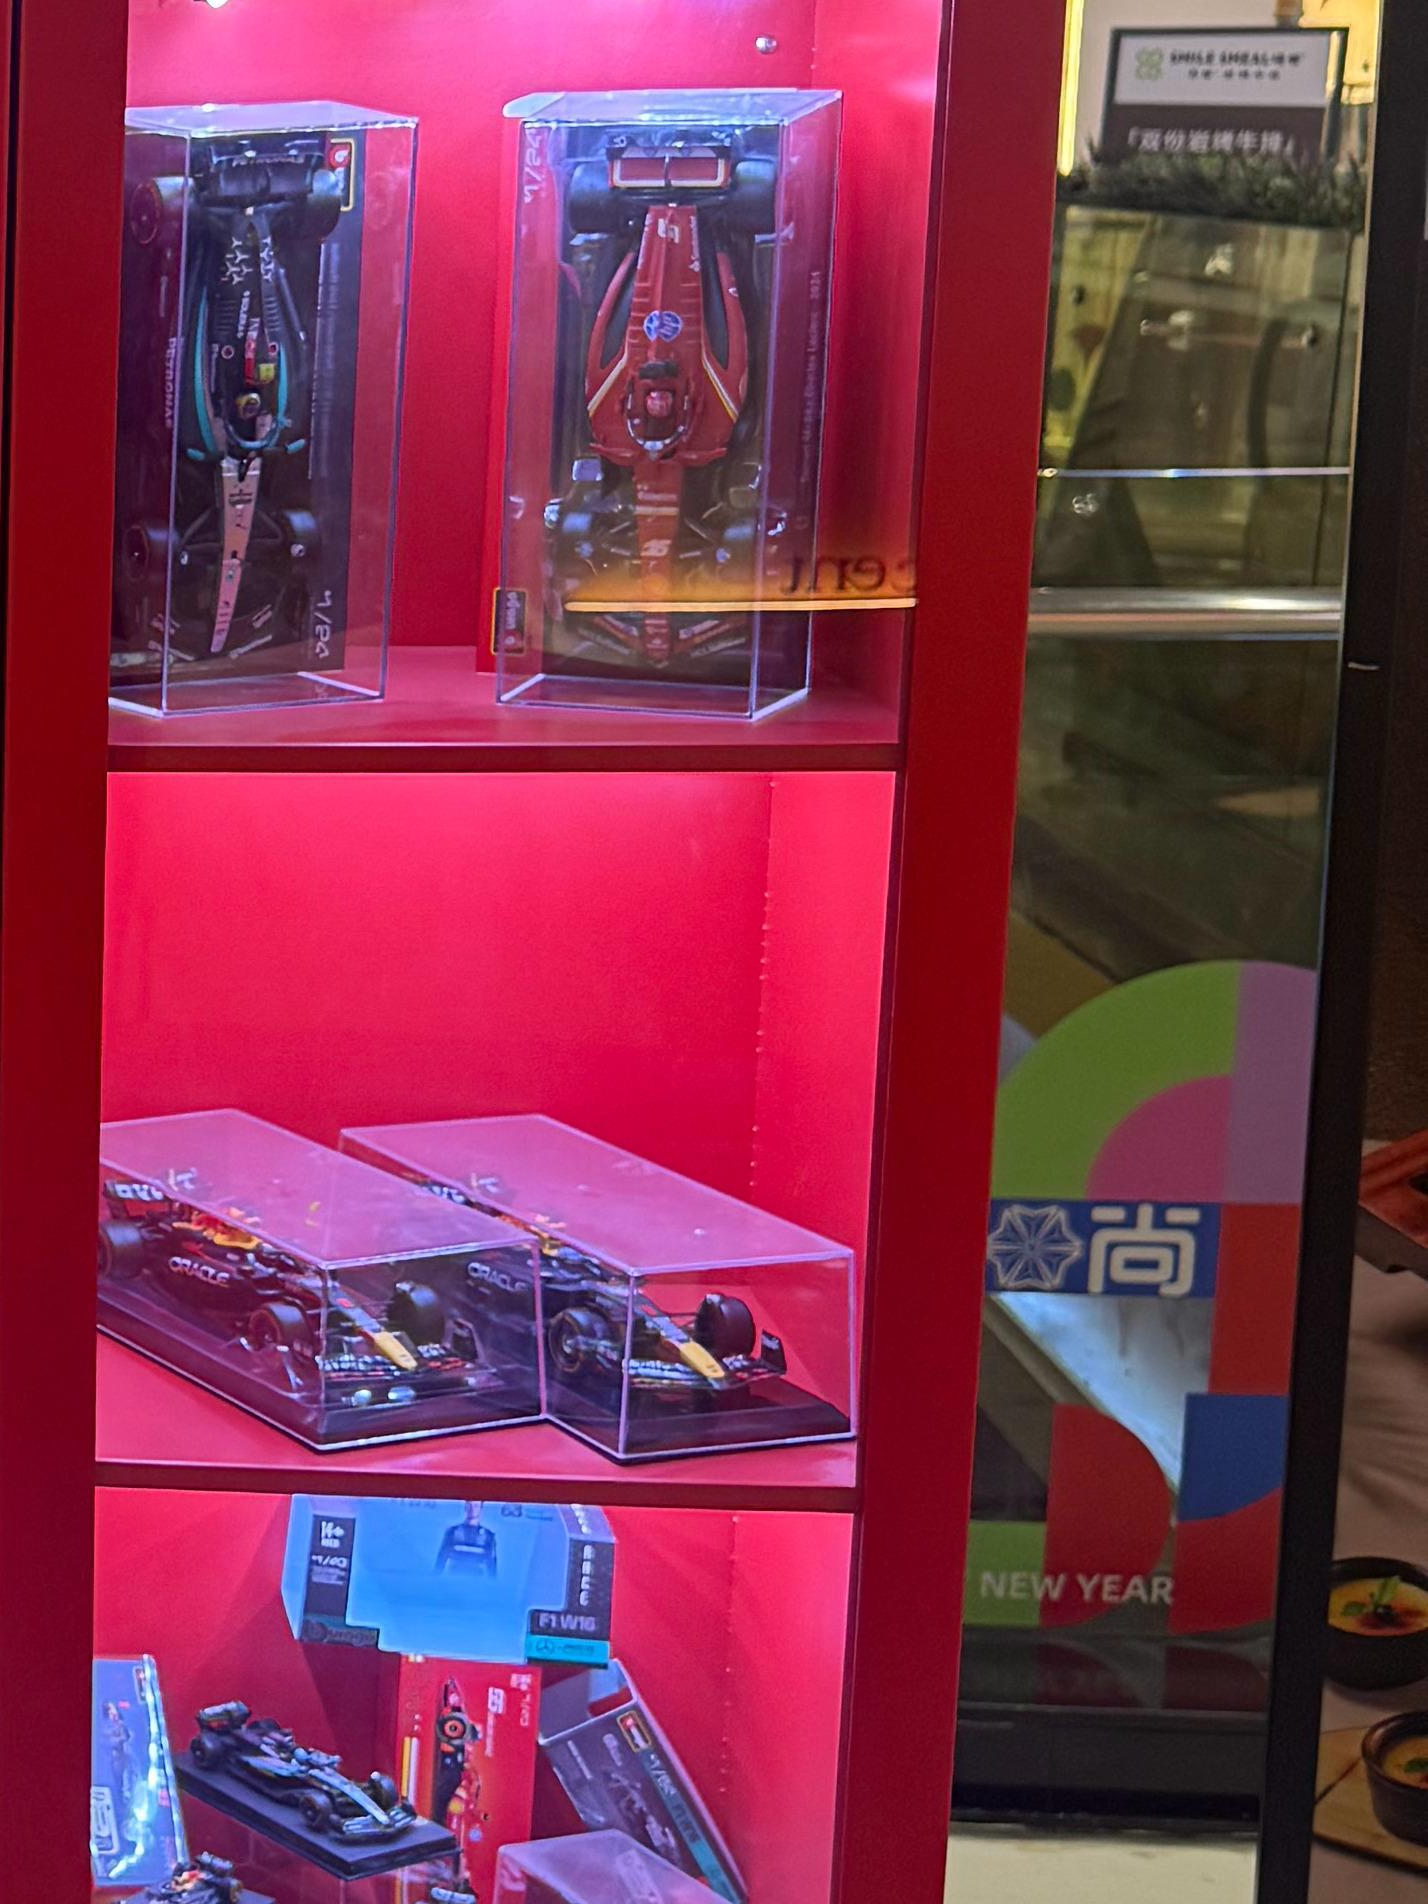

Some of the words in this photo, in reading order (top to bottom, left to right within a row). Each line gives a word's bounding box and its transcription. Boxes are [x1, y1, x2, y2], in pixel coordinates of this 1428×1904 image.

[1088, 1203, 1201, 1296] 尚
[167, 1254, 231, 1288] ORACLE
[466, 1262, 529, 1294] ORACLE
[980, 1571, 1069, 1601] NEW
[1076, 1572, 1173, 1604] YEAR
[540, 1613, 558, 1628] F1
